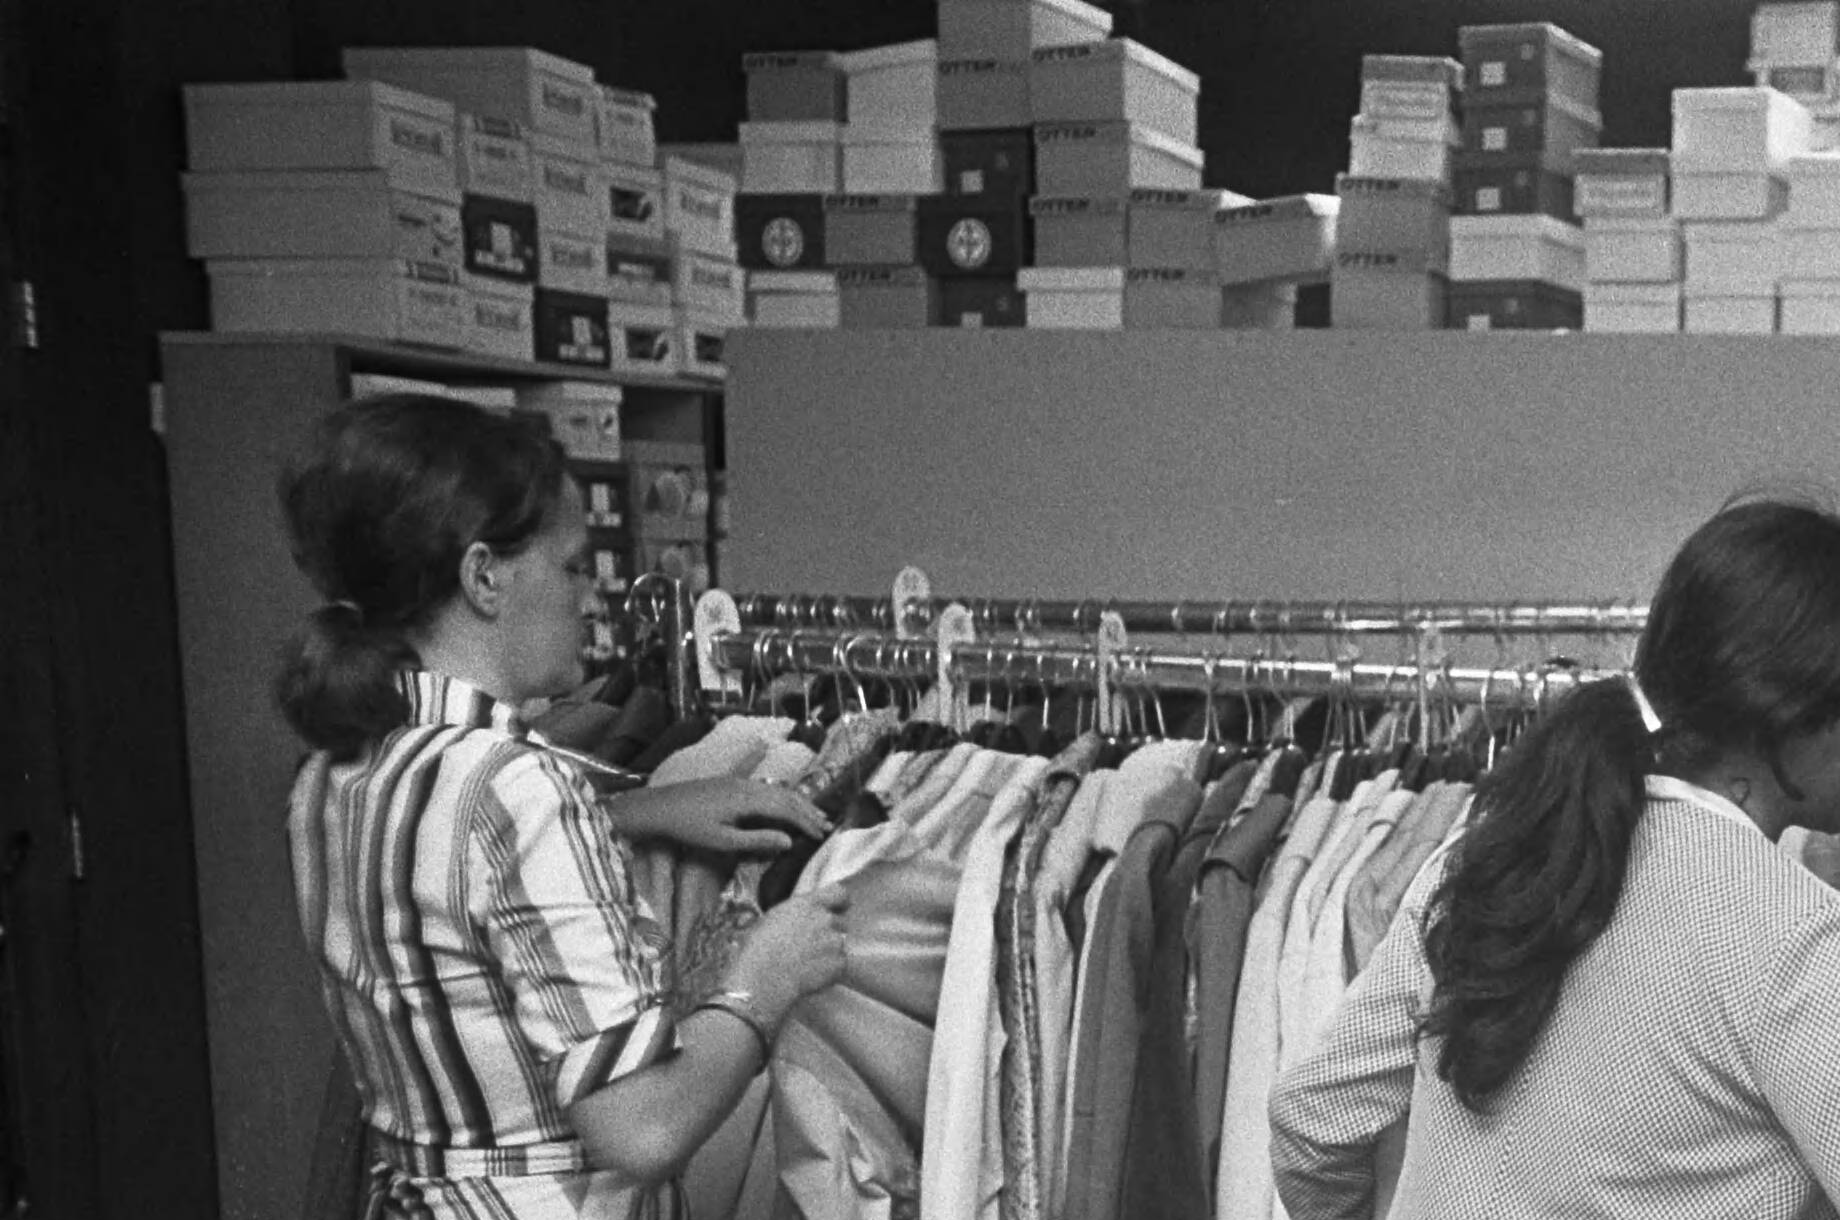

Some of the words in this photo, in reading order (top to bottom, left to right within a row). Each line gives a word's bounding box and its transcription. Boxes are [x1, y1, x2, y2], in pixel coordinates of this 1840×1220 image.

[1032, 46, 1091, 63] OTTER
[745, 56, 798, 69] OTTER
[939, 60, 997, 75] OTTER
[1038, 127, 1096, 142] OTTER
[1130, 190, 1189, 205] OTTER
[1033, 199, 1090, 213] OTTER
[1215, 206, 1273, 224] OTTER
[1128, 268, 1185, 282] OTTER
